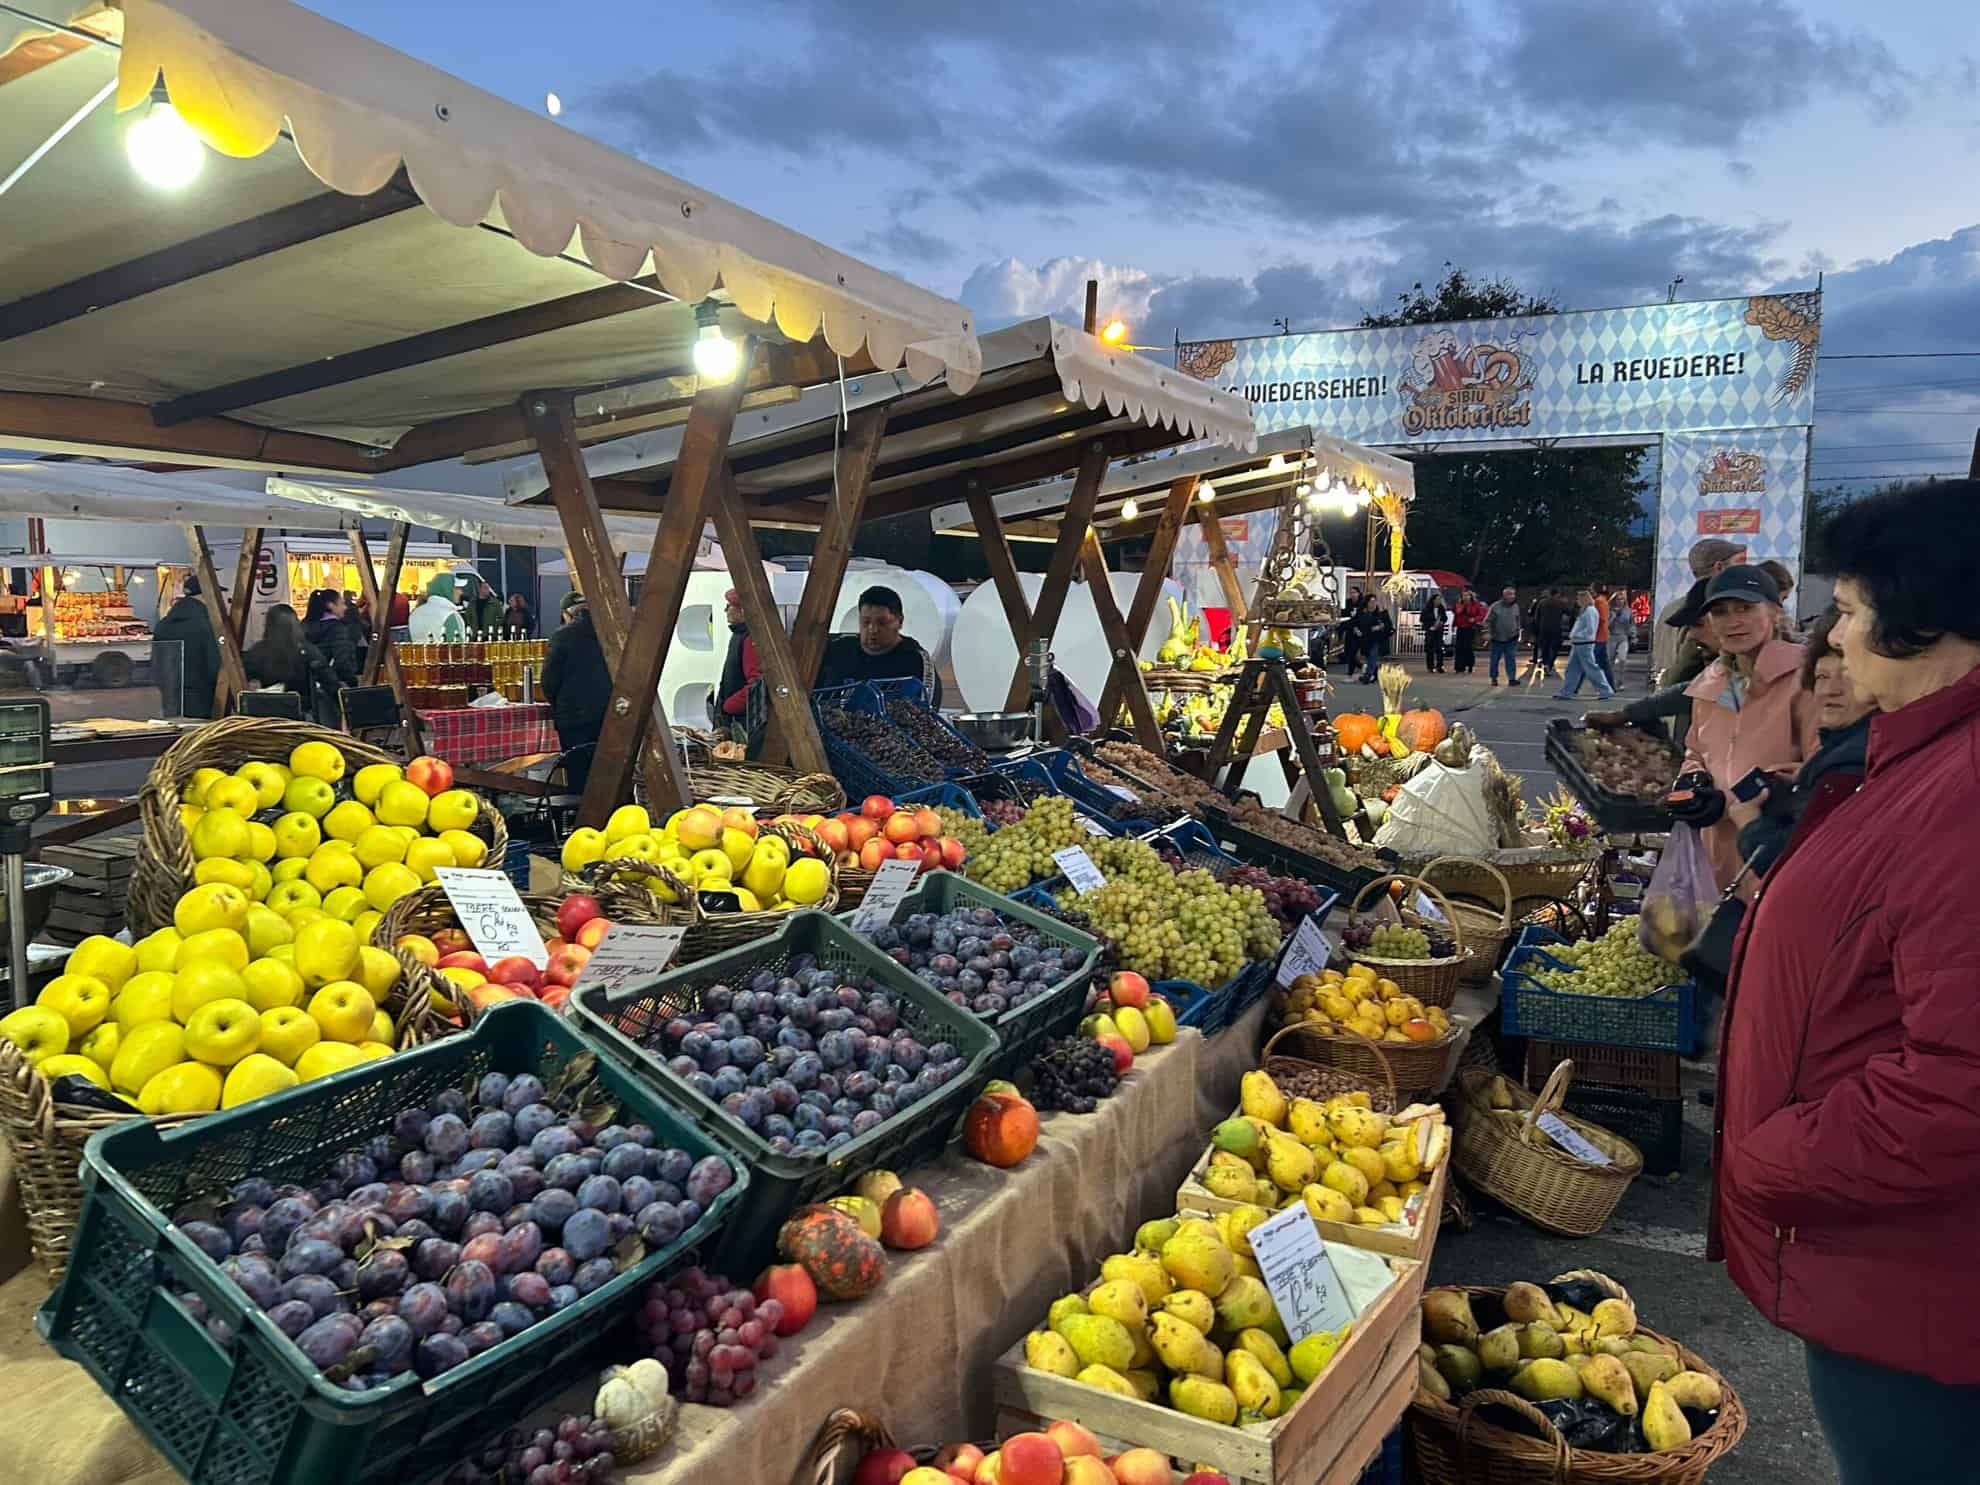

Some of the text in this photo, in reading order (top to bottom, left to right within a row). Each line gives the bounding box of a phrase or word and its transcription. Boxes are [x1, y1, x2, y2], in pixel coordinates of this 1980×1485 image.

[1577, 352, 1745, 384] LA REVEDERE!
[1245, 375, 1387, 404] WIEDERSEHEN!
[1448, 390, 1486, 404] SIBIU
[1403, 399, 1531, 437] Oktoberfest
[480, 913, 498, 940] 6
